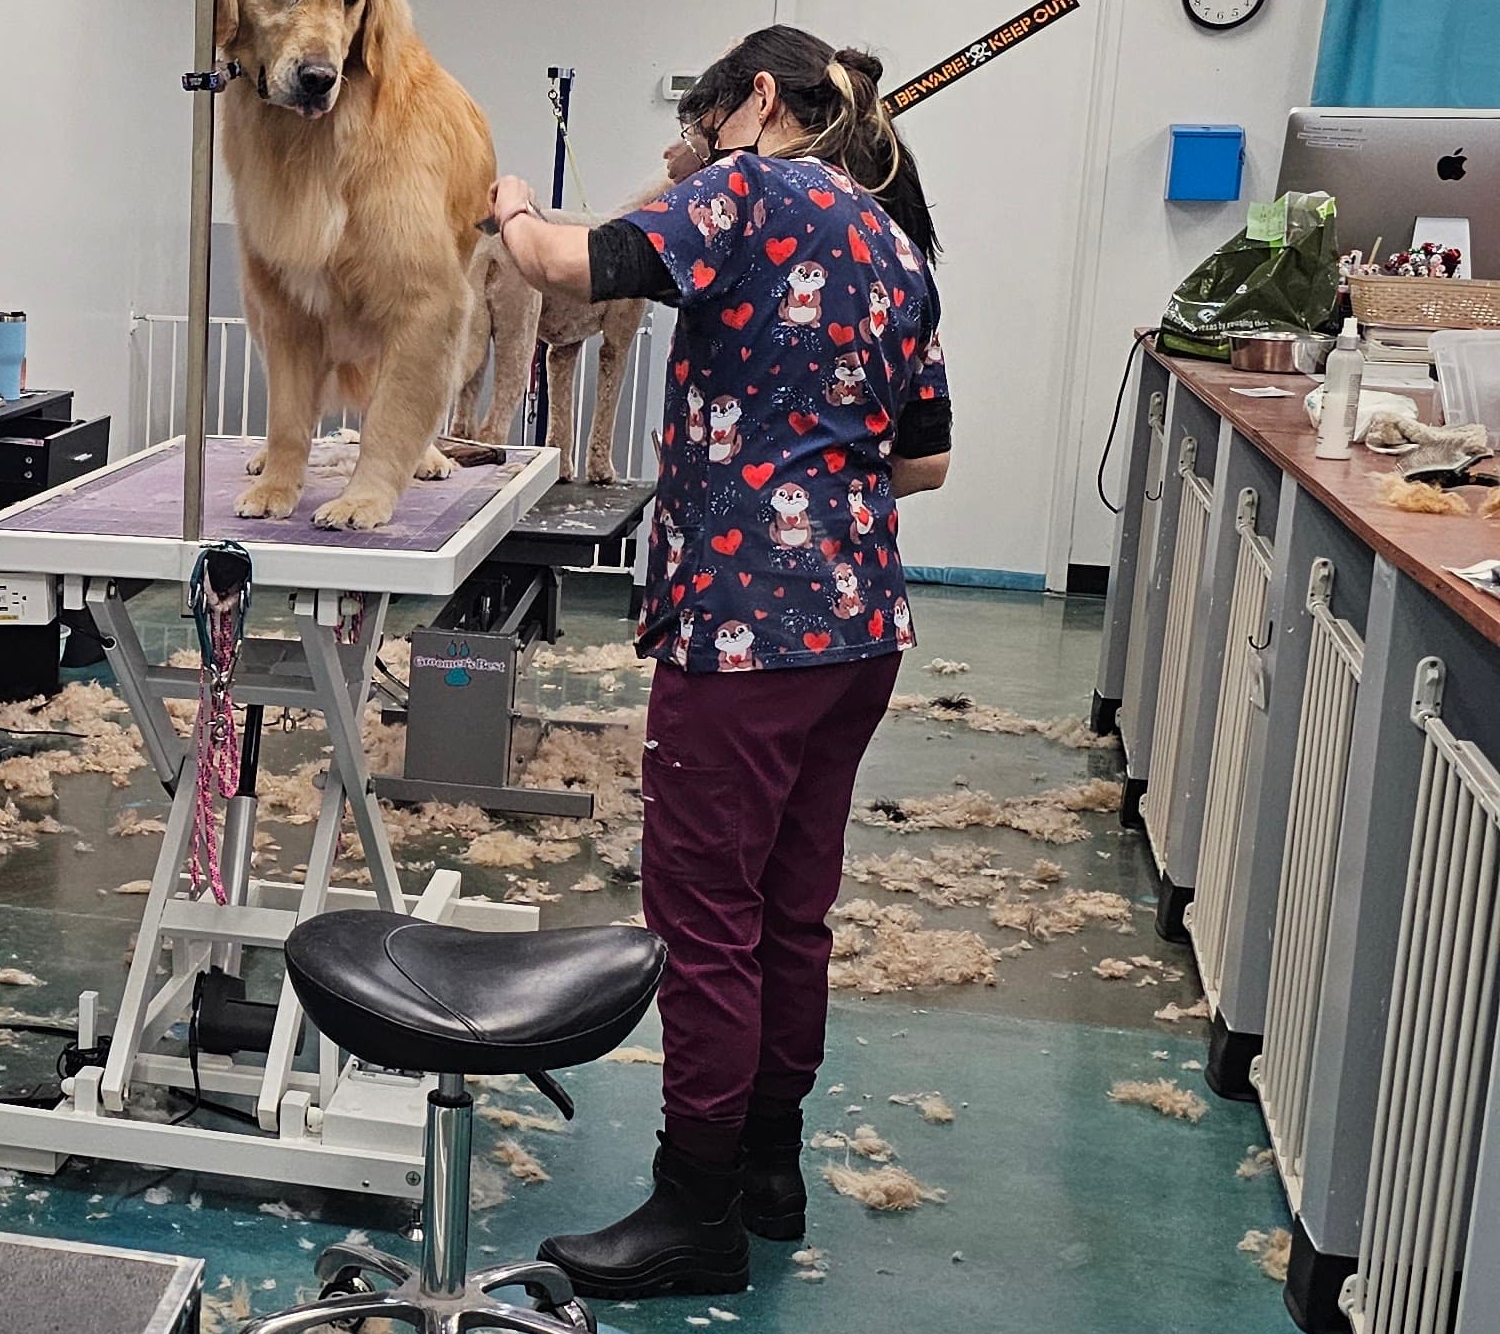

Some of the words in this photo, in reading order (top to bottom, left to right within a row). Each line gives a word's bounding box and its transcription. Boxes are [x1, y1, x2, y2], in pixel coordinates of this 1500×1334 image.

[1204, 7, 1211, 16] 7
[1217, 12, 1225, 20] 6
[1231, 8, 1239, 17] 5
[894, 55, 970, 108] BEWARE!
[987, 17, 1031, 52] KEEP
[476, 658, 506, 673] Best
